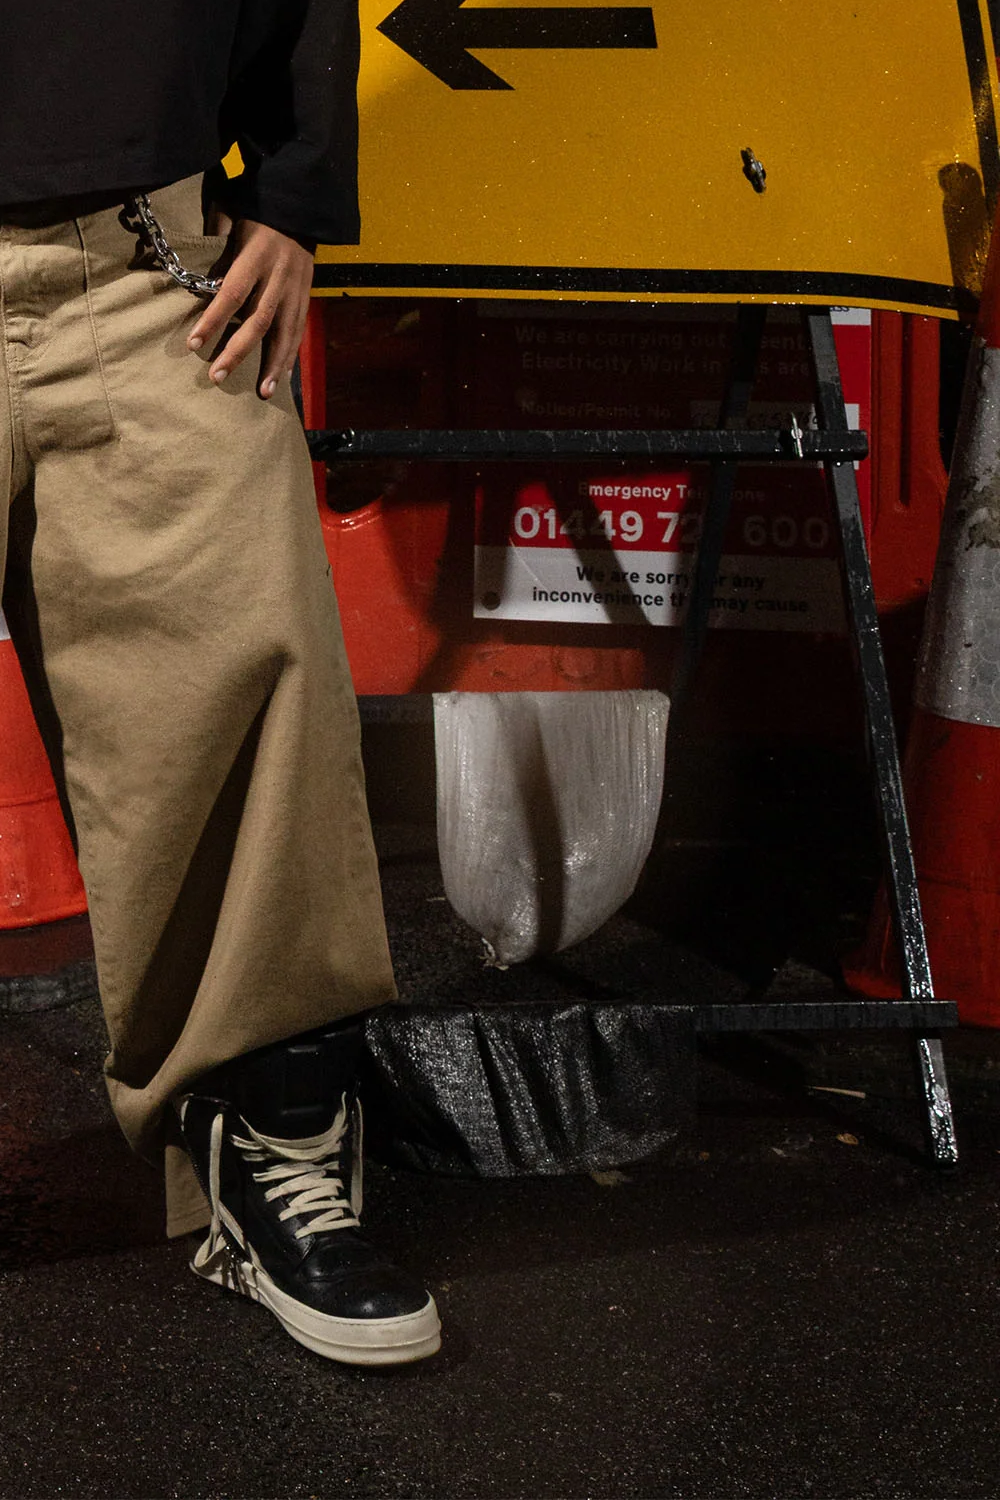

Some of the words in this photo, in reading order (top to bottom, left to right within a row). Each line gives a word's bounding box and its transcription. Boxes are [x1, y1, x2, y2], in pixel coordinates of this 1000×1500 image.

[777, 359, 811, 377] are
[578, 481, 672, 501] Emergency
[656, 510, 705, 546] 72
[743, 514, 829, 550] 600
[576, 566, 604, 583] We
[611, 570, 640, 584] are
[733, 575, 766, 591] any
[532, 586, 664, 606] inconvenience
[754, 598, 809, 613] cause
